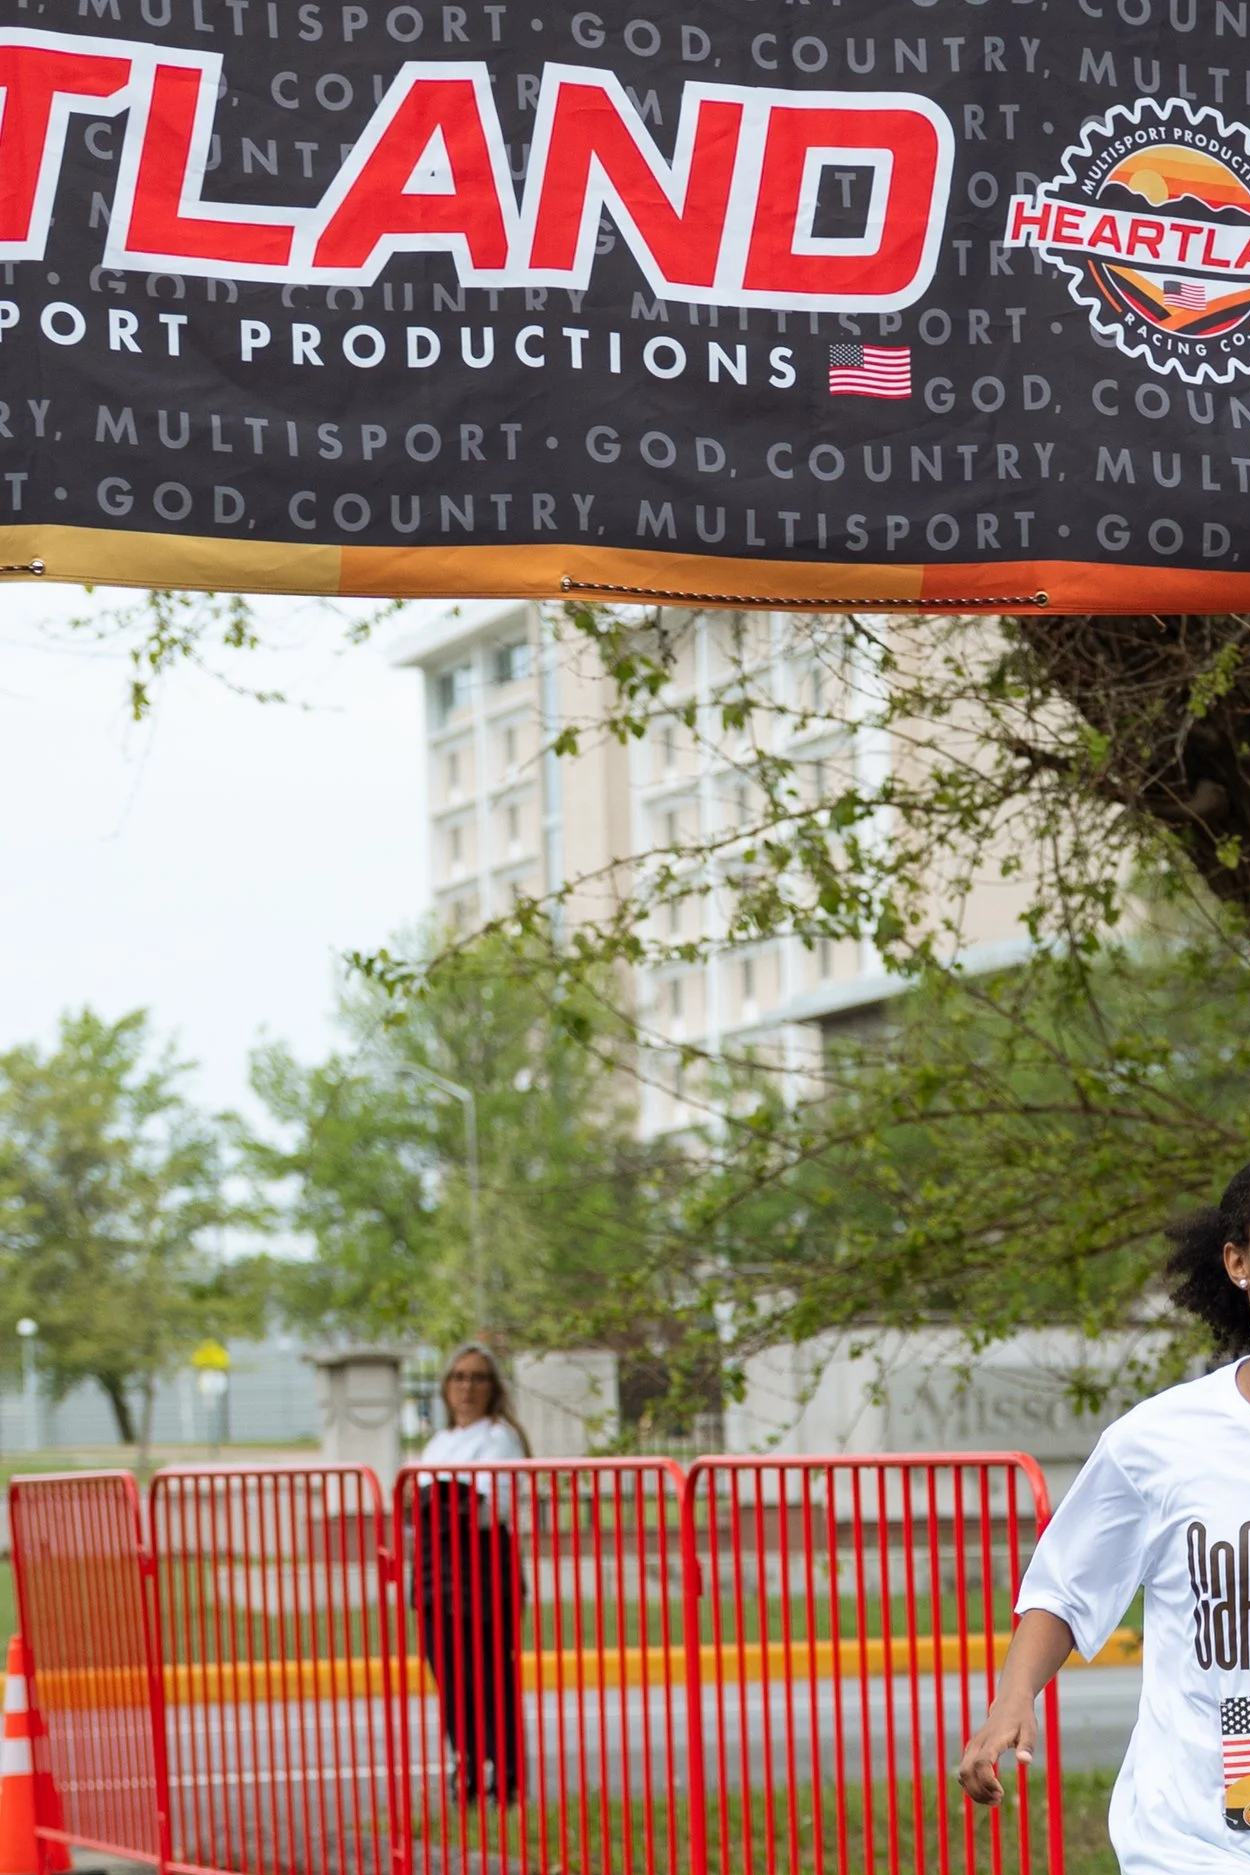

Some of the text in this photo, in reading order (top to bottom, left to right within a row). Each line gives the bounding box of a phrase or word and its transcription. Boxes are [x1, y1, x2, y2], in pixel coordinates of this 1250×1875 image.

[570, 12, 722, 68] GOD,
[751, 32, 1050, 79] COUNTRY,
[1081, 126, 1167, 196] MULTISPORT
[240, 319, 796, 389] PRODUCTIONS
[1124, 312, 1208, 357] RACING
[924, 374, 1062, 414] GOD,
[95, 405, 522, 463] MULTISPORT
[585, 425, 736, 478] GOD,
[766, 442, 1066, 483] COUNTRY,
[97, 476, 256, 529] GOD,
[288, 491, 605, 535] COUNTRY,
[636, 499, 1036, 552] MULTISPORT
[1096, 514, 1240, 562] GOD,
